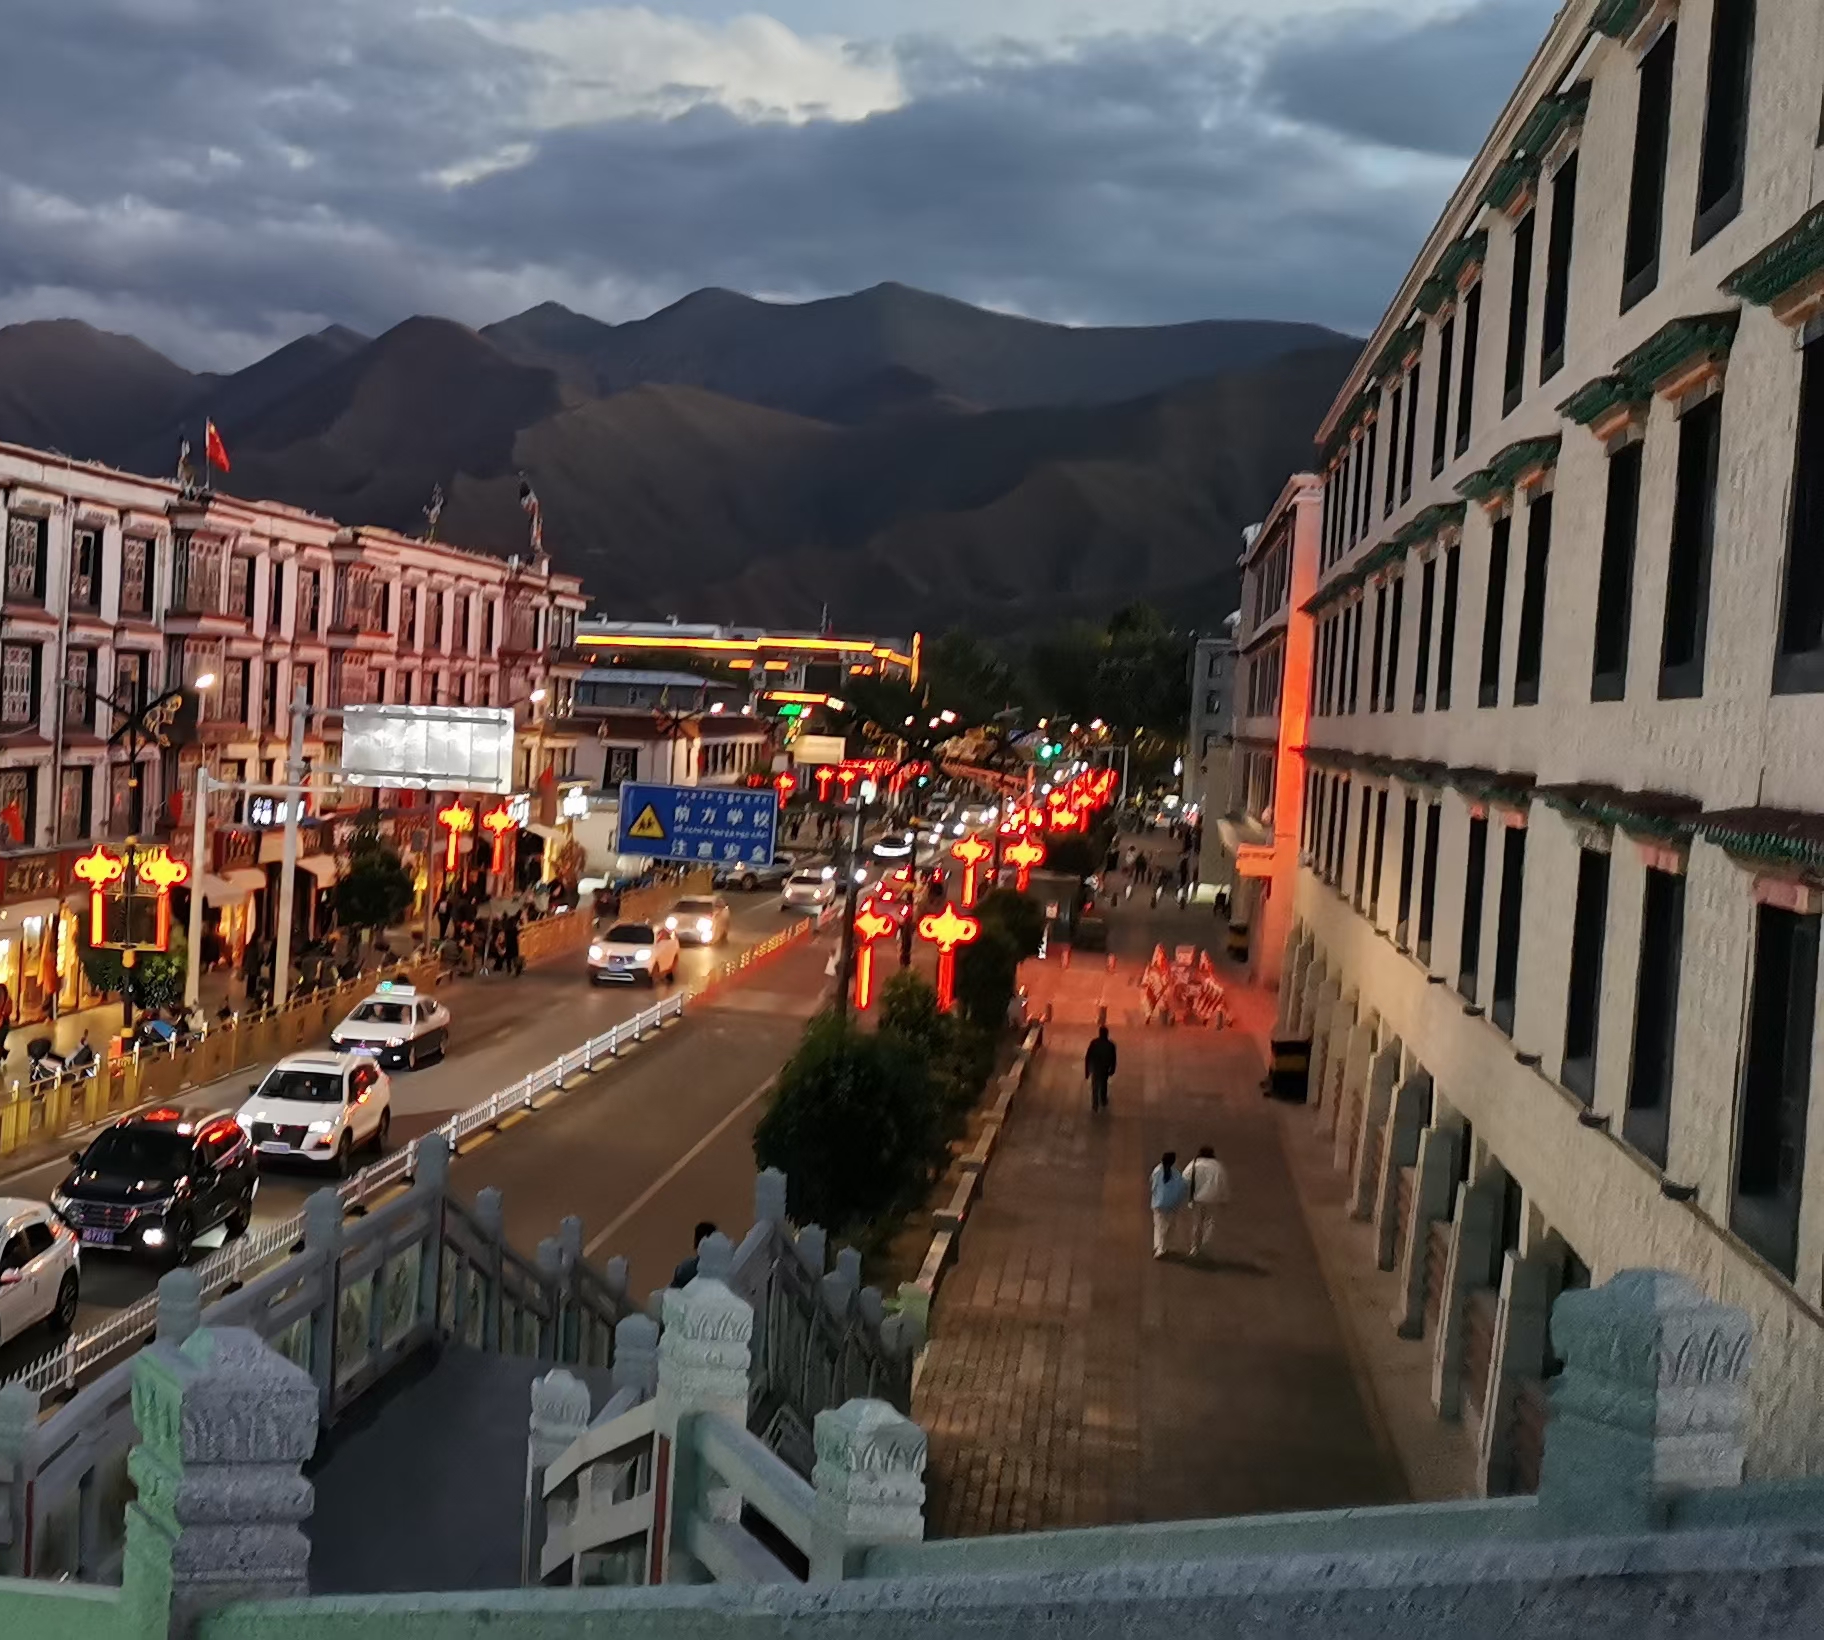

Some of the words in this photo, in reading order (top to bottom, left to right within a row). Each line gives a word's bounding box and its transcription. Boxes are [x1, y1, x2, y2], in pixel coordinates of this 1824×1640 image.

[674, 804, 771, 829] 前方学校
[671, 839, 766, 862] 注意安全
